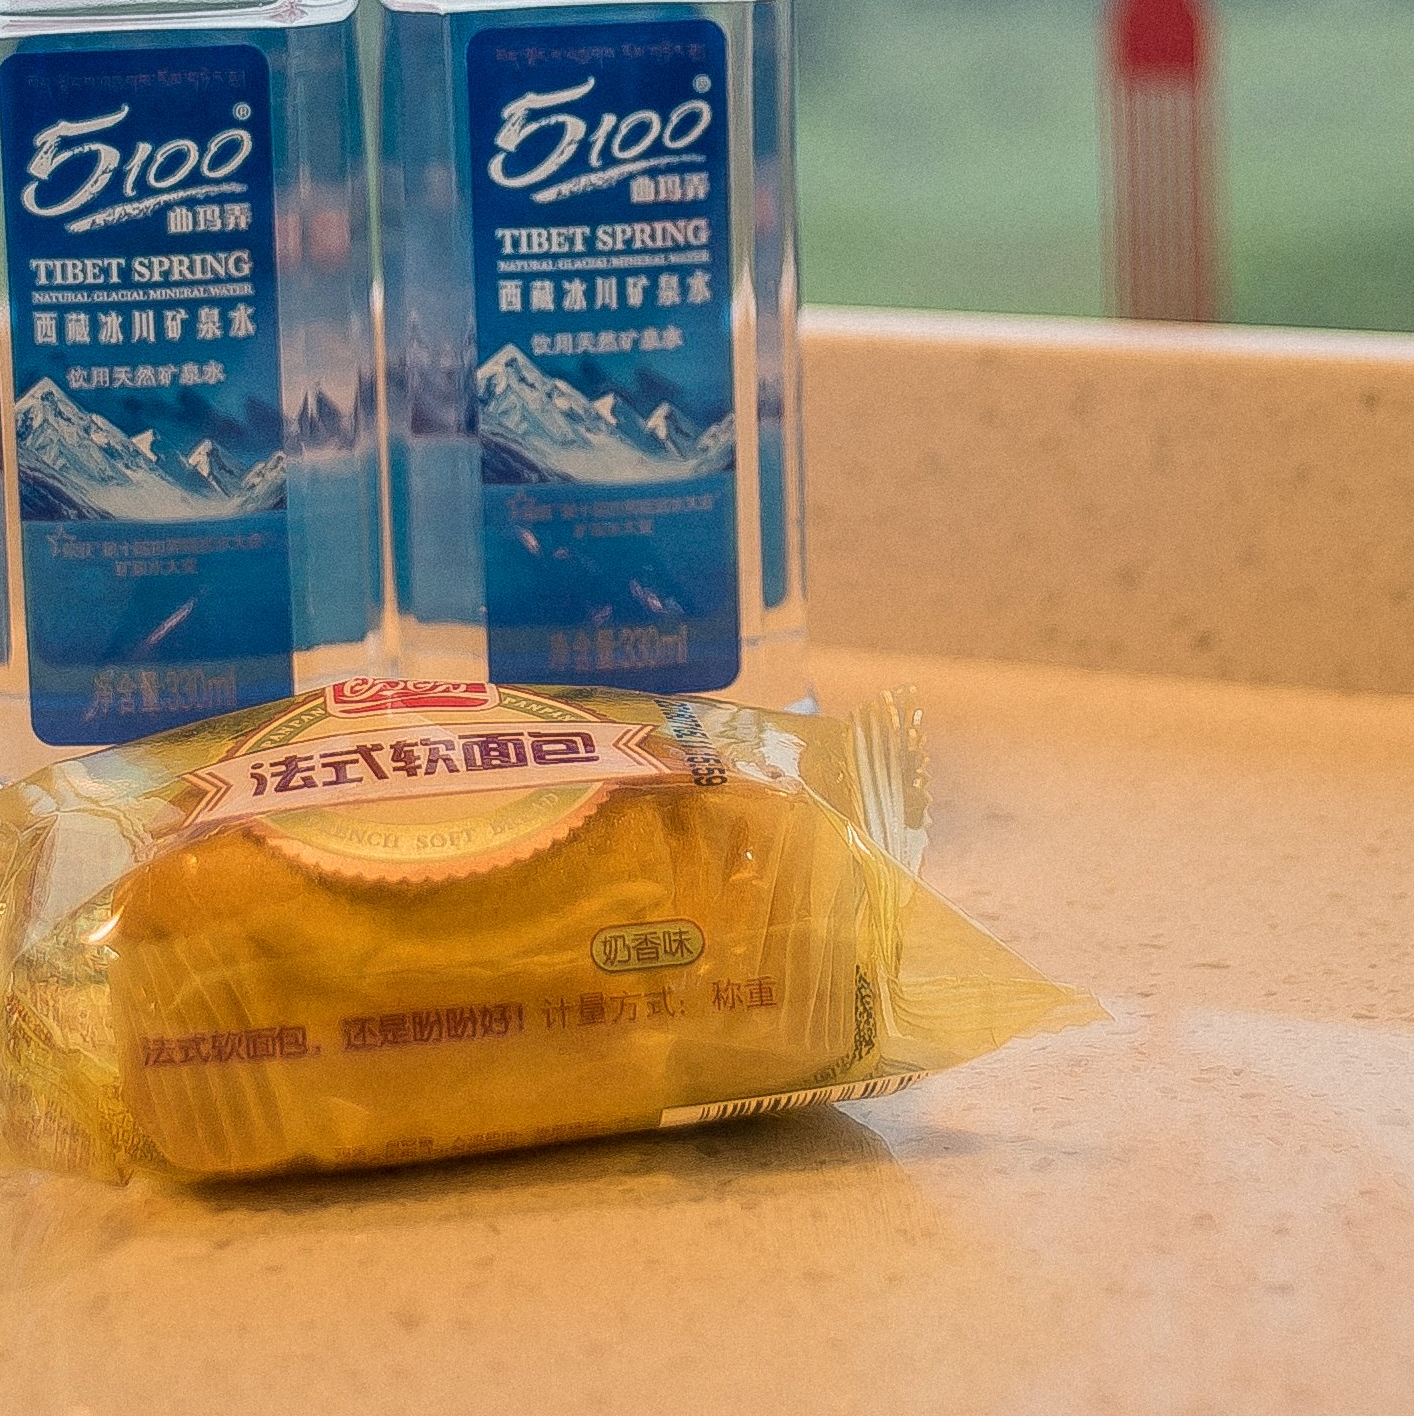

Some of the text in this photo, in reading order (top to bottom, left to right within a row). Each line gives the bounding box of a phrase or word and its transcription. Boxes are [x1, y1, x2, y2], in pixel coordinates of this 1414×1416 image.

[488, 76, 713, 189] 5100
[22, 103, 253, 216] 5100
[495, 217, 709, 255] TIBET SPRING
[30, 249, 254, 285] TIBET SPRING
[32, 282, 254, 304] NATURAL GLACIAL MINERAL WATER
[33, 302, 256, 345] 西藏冰川矿泉水
[260, 707, 326, 748] PANPAN
[250, 731, 600, 796] 法式软面包
[415, 825, 475, 850] SOFT
[600, 928, 694, 967] 奶香味
